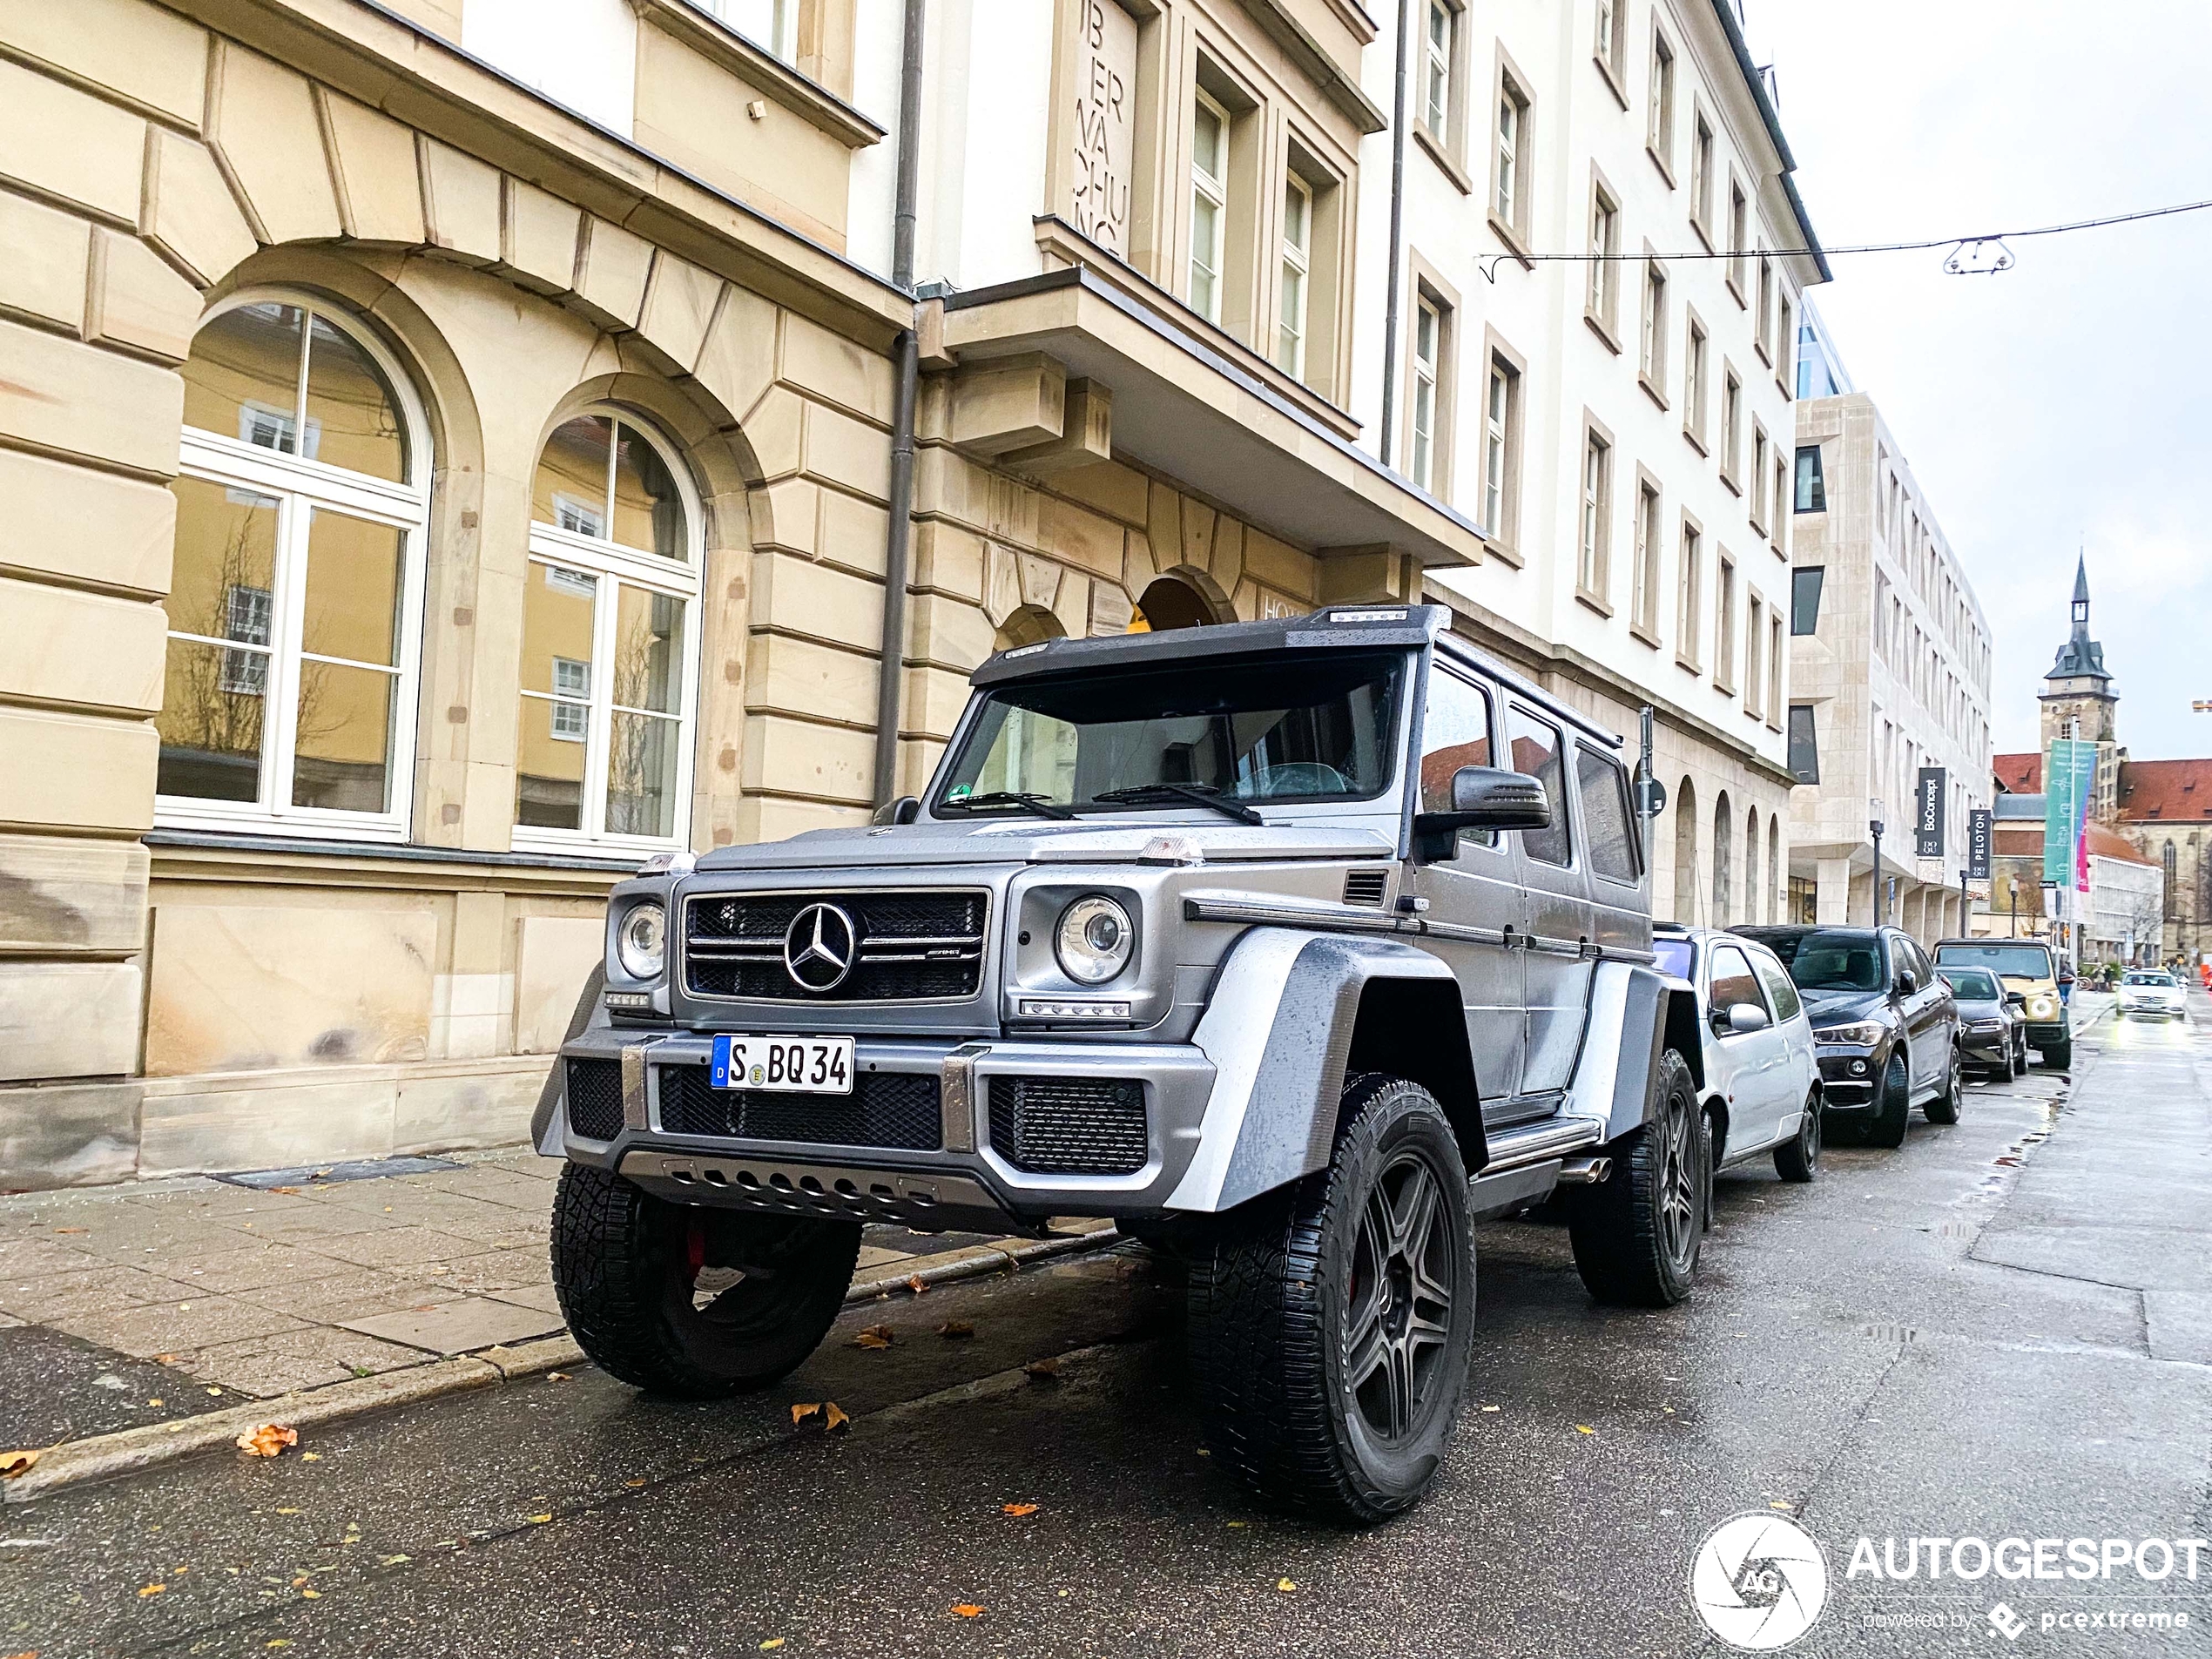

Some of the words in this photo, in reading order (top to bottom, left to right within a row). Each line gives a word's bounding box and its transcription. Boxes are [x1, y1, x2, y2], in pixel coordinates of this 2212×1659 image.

[1090, 57, 1123, 124] ER
[1924, 779, 1939, 831] BoConcept
[1974, 813, 1986, 861] PELOTON
[717, 1067, 725, 1079] D
[730, 1044, 746, 1082] S
[768, 1045, 804, 1084] BQ
[811, 1046, 846, 1085] 34
